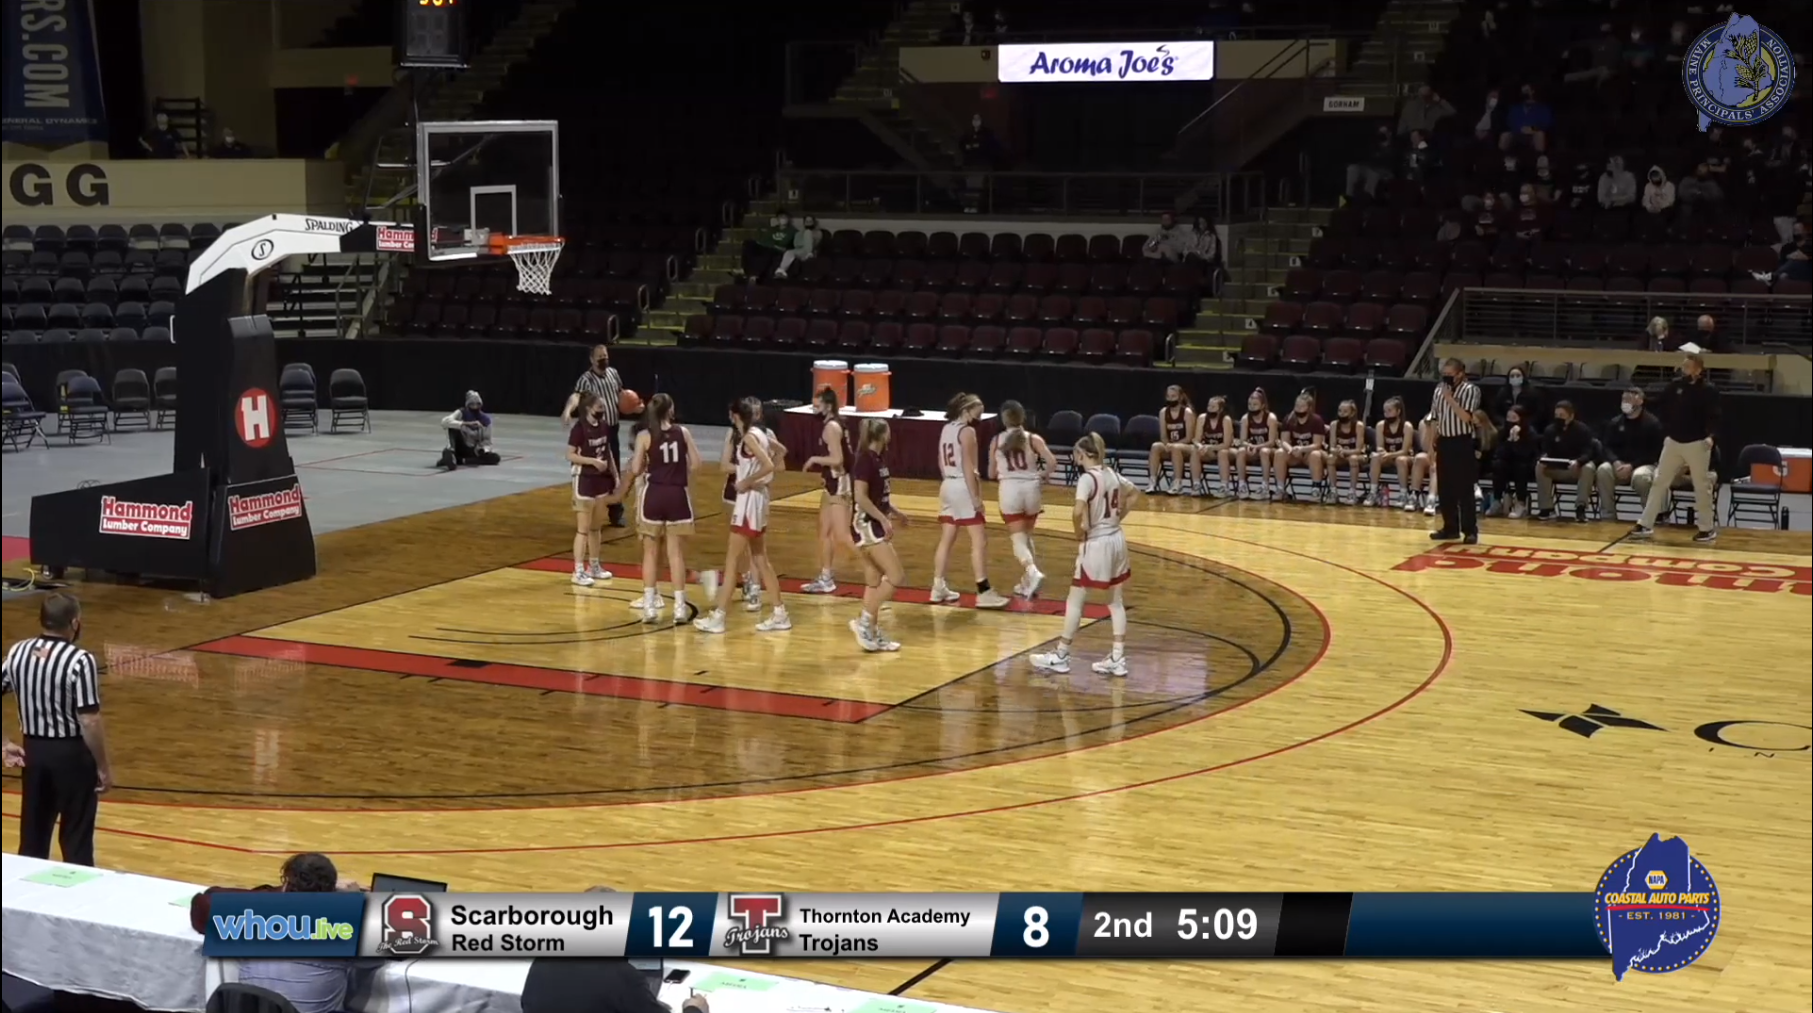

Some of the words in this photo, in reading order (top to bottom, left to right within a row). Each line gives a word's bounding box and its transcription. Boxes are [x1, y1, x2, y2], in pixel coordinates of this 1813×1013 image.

[1029, 51, 1112, 76] Aroma
[305, 218, 354, 233] SPALDING
[241, 395, 270, 441] H
[660, 442, 679, 463] 11
[943, 443, 956, 467] 12
[1006, 449, 1028, 471] 10
[102, 497, 193, 521] Hammond
[229, 485, 300, 514] Hammond
[1103, 488, 1121, 519] 14
[102, 518, 138, 531] Lumber
[141, 521, 188, 536] Company
[232, 511, 262, 526] Lumber
[263, 505, 300, 521] Company
